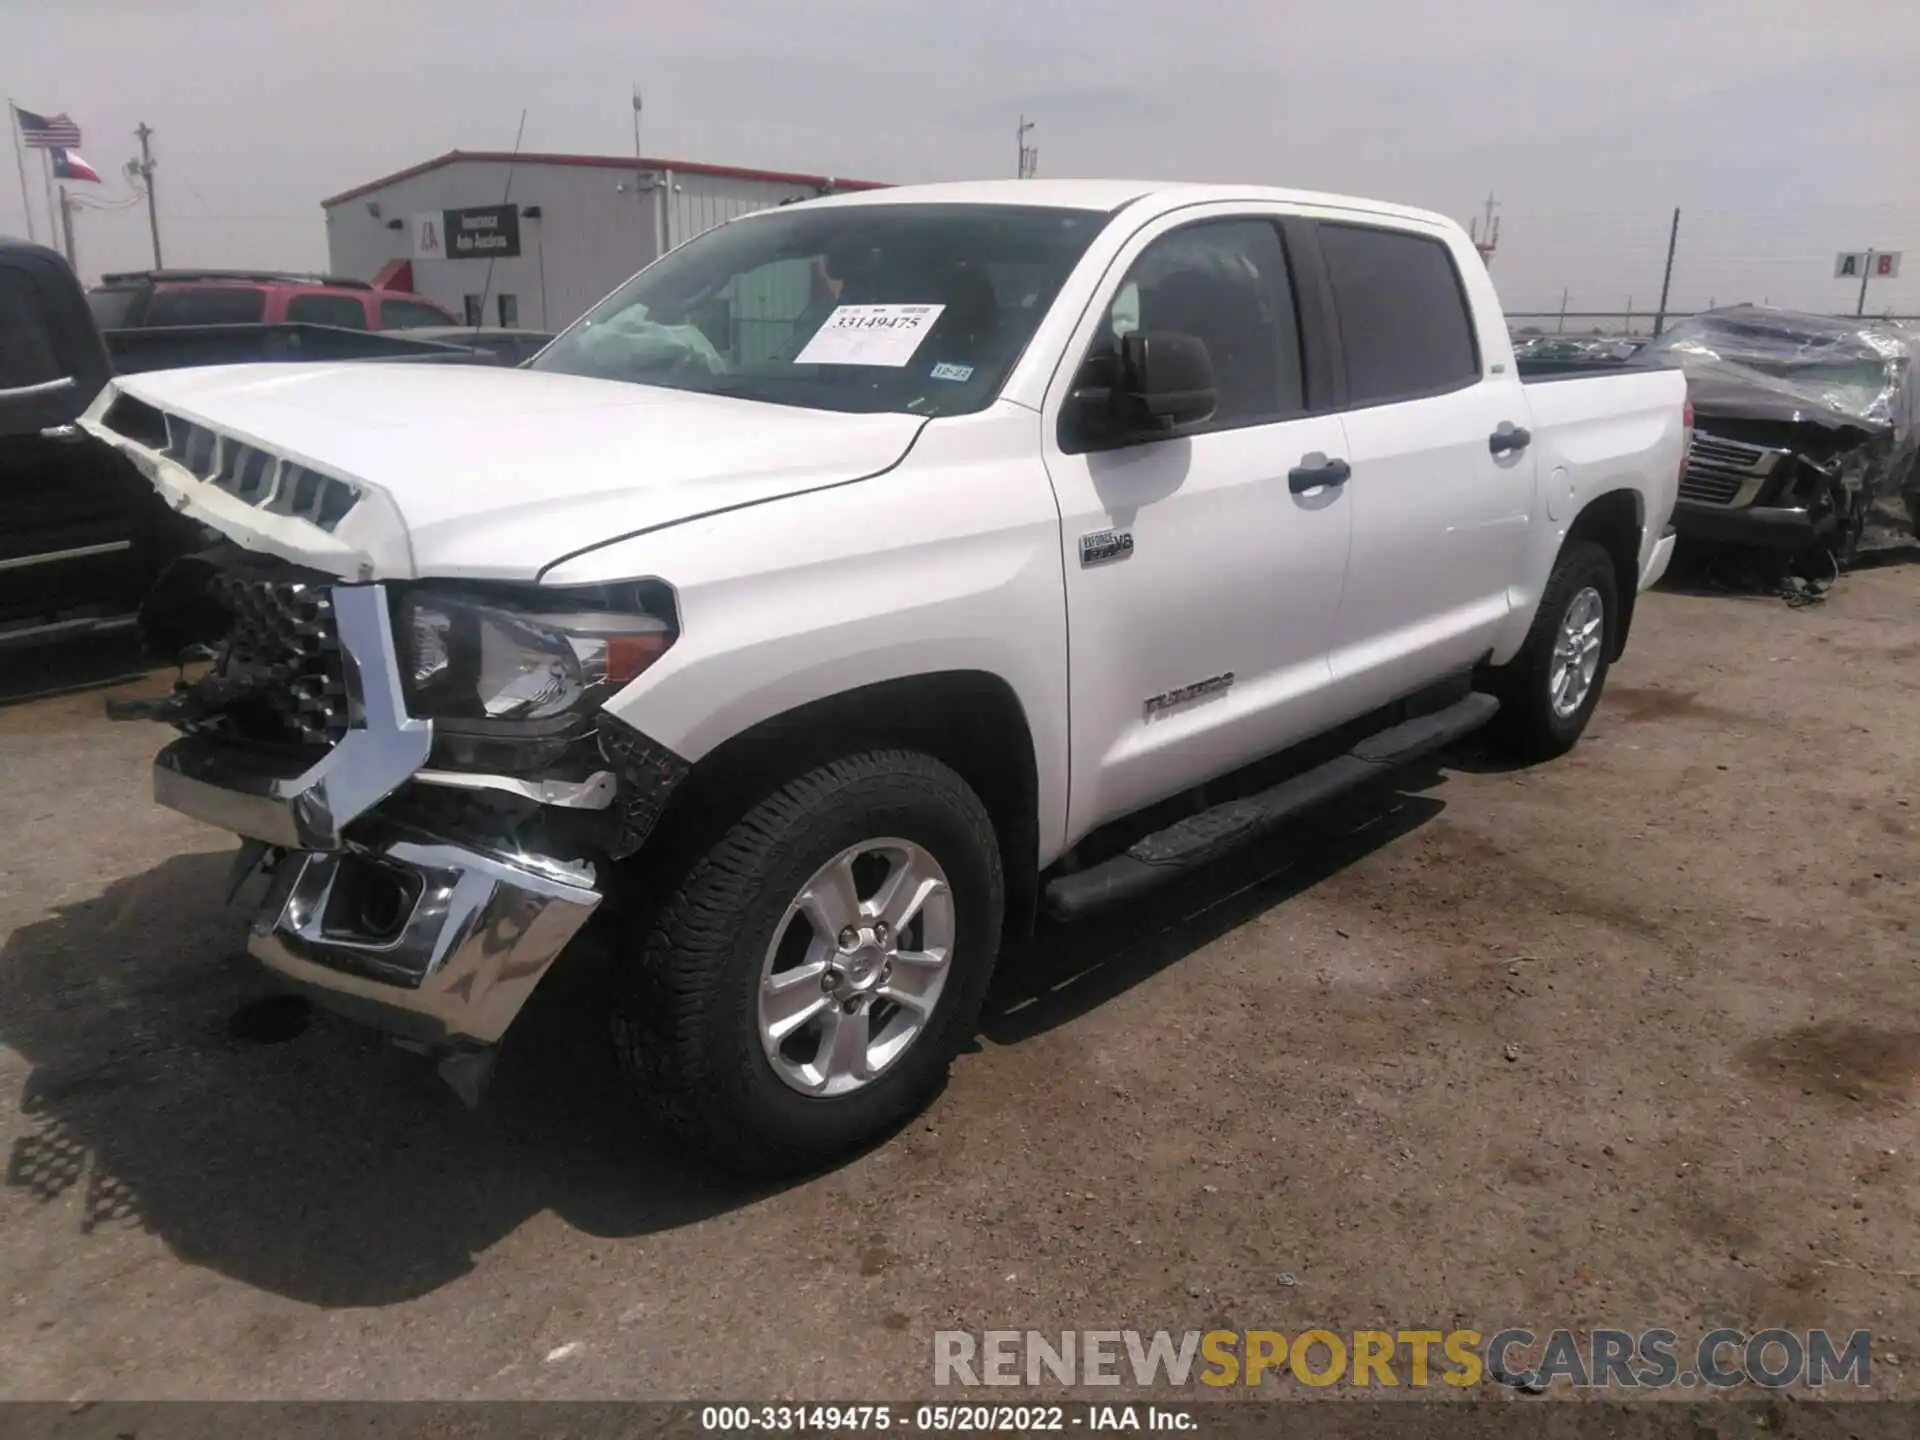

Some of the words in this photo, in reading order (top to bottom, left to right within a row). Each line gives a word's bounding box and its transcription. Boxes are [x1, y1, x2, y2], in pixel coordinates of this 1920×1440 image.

[1841, 255, 1856, 275] A
[1877, 254, 1893, 275] B
[831, 317, 922, 329] 33149475
